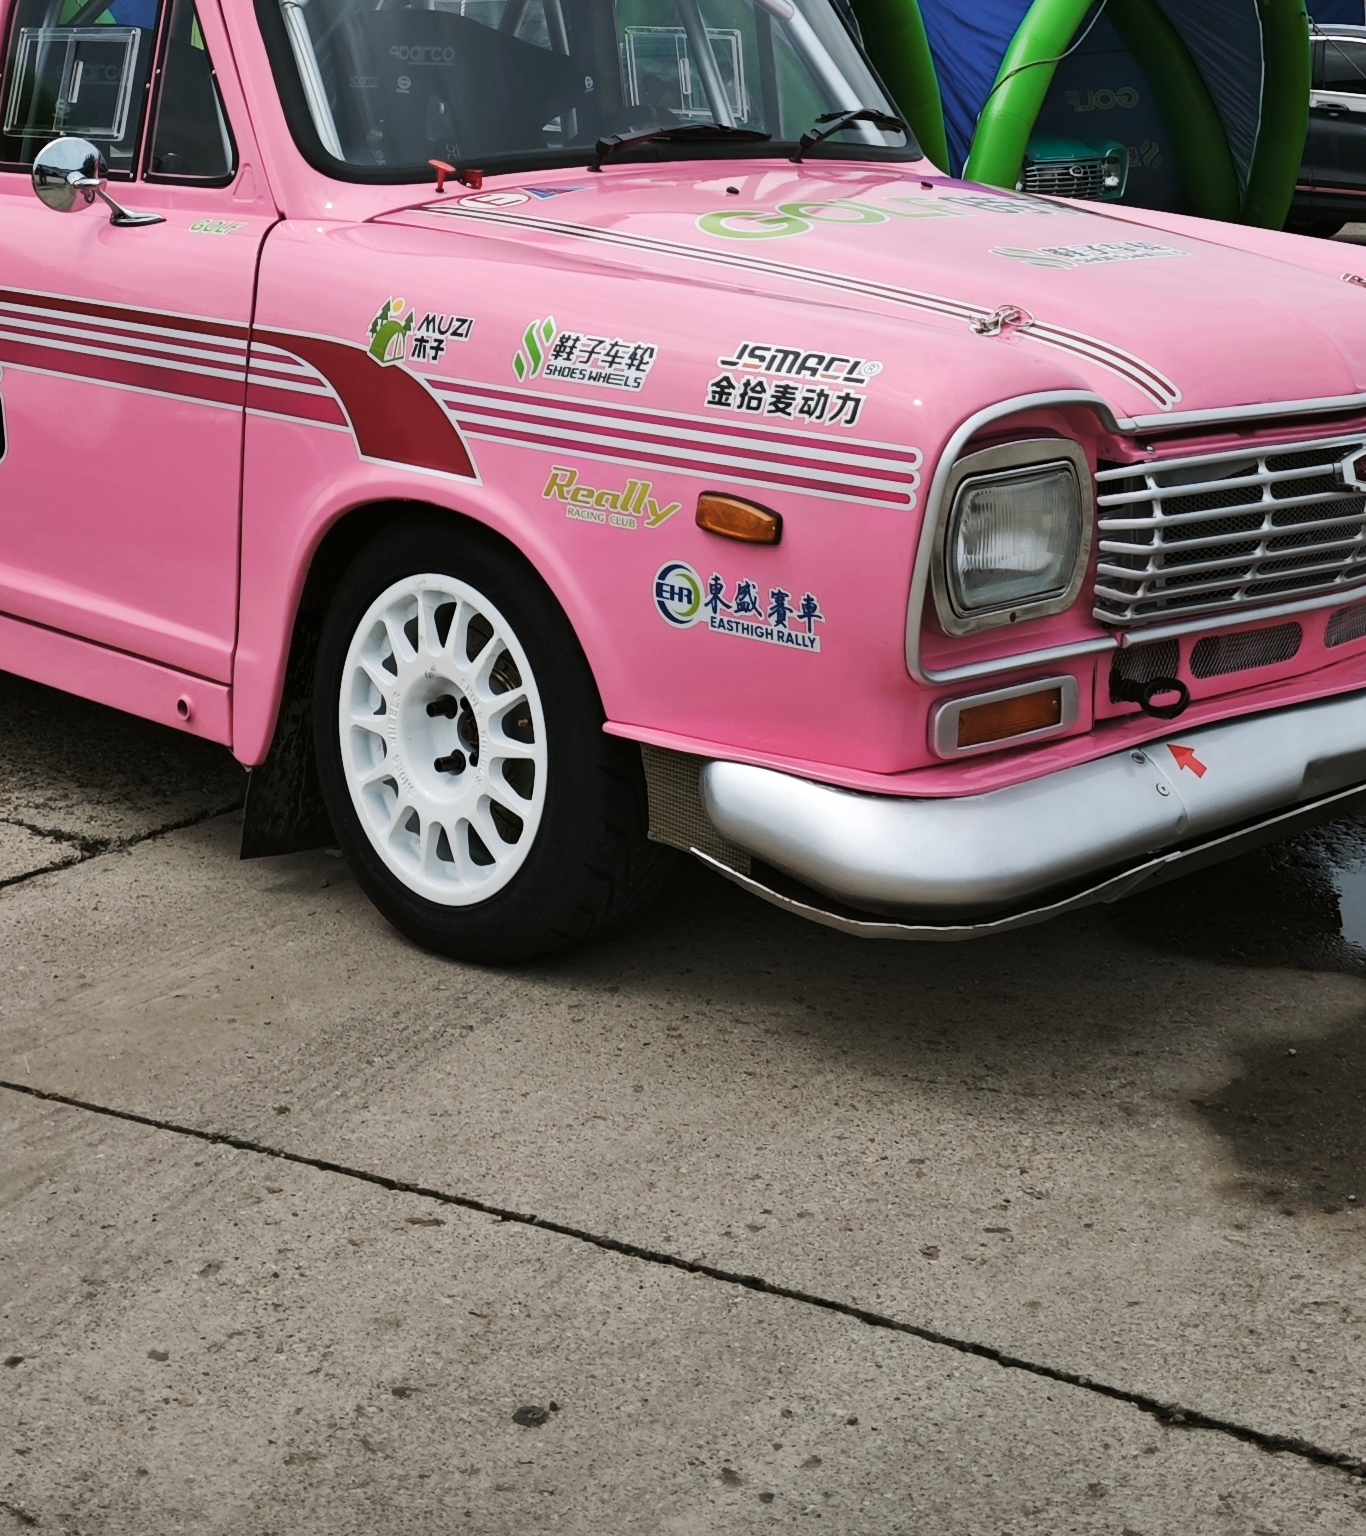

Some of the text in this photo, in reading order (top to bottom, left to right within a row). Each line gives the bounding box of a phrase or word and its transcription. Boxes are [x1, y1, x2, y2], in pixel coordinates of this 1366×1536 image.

[389, 45, 455, 62] sparco
[417, 313, 474, 339] MUZI
[411, 335, 445, 361] 木子
[551, 333, 654, 373] 鞋子车轮
[544, 363, 587, 381] SHOES
[707, 375, 862, 425] 金拾麦动力
[543, 465, 681, 527] Really
[567, 507, 637, 529] RACING CLUB
[655, 582, 693, 604] EHR
[704, 574, 823, 634] 東盛賽車
[710, 616, 816, 649] EASTHIGH RALLY
